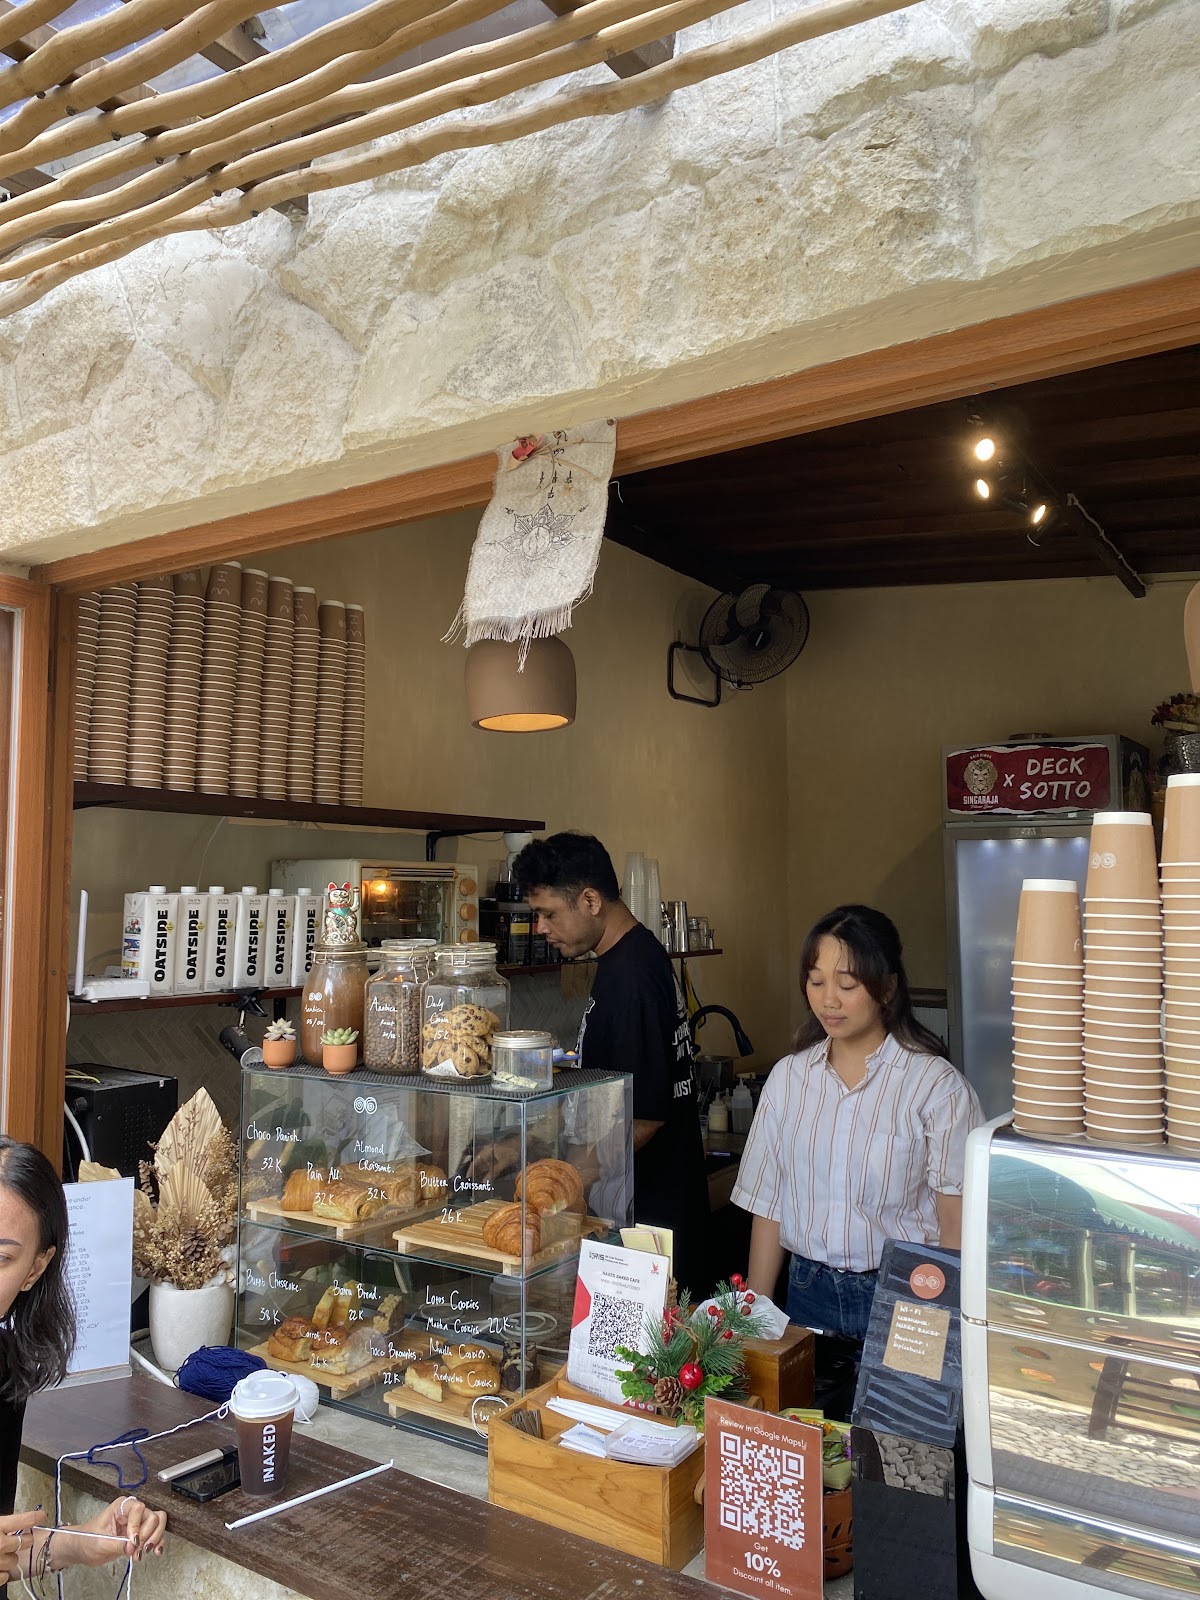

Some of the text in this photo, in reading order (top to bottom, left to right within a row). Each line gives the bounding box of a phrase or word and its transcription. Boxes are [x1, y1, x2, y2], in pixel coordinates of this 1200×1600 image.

[1026, 756, 1085, 776] DECK
[963, 795, 999, 805] SINGARAJA
[1019, 780, 1091, 800] SOTTO
[154, 909, 169, 982] OATSIDE
[186, 909, 199, 980] OATSIDE
[215, 909, 228, 978] OATSIDE
[246, 909, 260, 976] OATSIDE
[274, 909, 287, 975] OATSIDE
[673, 1079, 692, 1098] JUST
[246, 1120, 271, 1140] Choco
[306, 1160, 323, 1181] Pain
[420, 1170, 448, 1189] Butter
[720, 1416, 744, 1430] Review
[753, 1426, 780, 1441] Google
[781, 1435, 804, 1448] Maps!
[262, 1424, 276, 1479] NAKED
[753, 1541, 768, 1552] Get
[744, 1551, 782, 1578] 10%
[733, 1567, 793, 1596] Discount all item.
